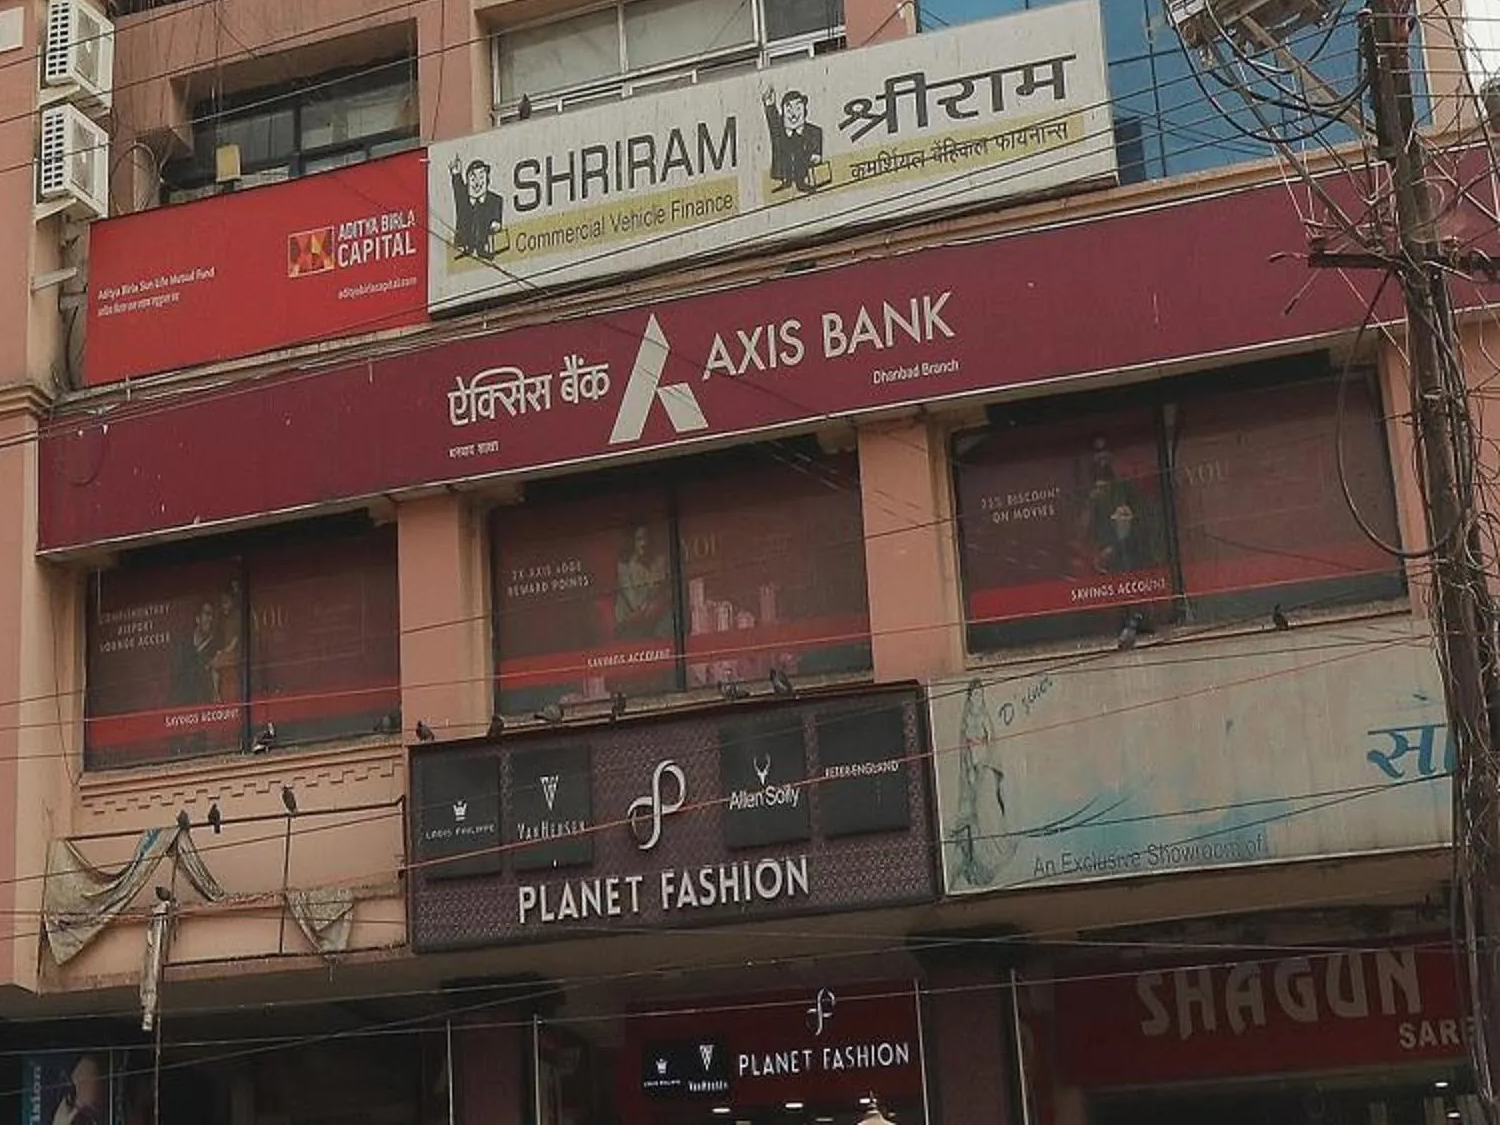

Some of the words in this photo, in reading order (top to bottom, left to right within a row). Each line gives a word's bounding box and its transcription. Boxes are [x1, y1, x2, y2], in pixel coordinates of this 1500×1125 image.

[837, 53, 1077, 144] श्रीराम
[512, 115, 738, 213] SHRIRAM
[338, 216, 379, 241] ADITYA
[380, 208, 416, 231] BIRLA
[515, 214, 606, 254] Commercial
[609, 205, 665, 235] Vehicle
[670, 192, 734, 222] Finance
[337, 227, 417, 269] CAPITAL
[702, 318, 806, 381] AXIS
[821, 290, 956, 359] BANK
[559, 353, 610, 405] बैंक
[873, 362, 920, 385] Dhanbad
[921, 358, 960, 377] Branch
[1117, 576, 1167, 597] ACCOUNT
[729, 787, 764, 811] Allen
[765, 782, 800, 808] Solly
[1033, 856, 1056, 877] An
[1061, 848, 1142, 876] Exclusive
[1146, 839, 1241, 866] Showroom
[1245, 833, 1266, 856] of
[518, 875, 644, 925] PLANET
[661, 854, 810, 911] FASHION
[1135, 947, 1421, 1041] SHAGUN
[738, 1048, 813, 1077] PLANET
[822, 1042, 910, 1072] FASHION
